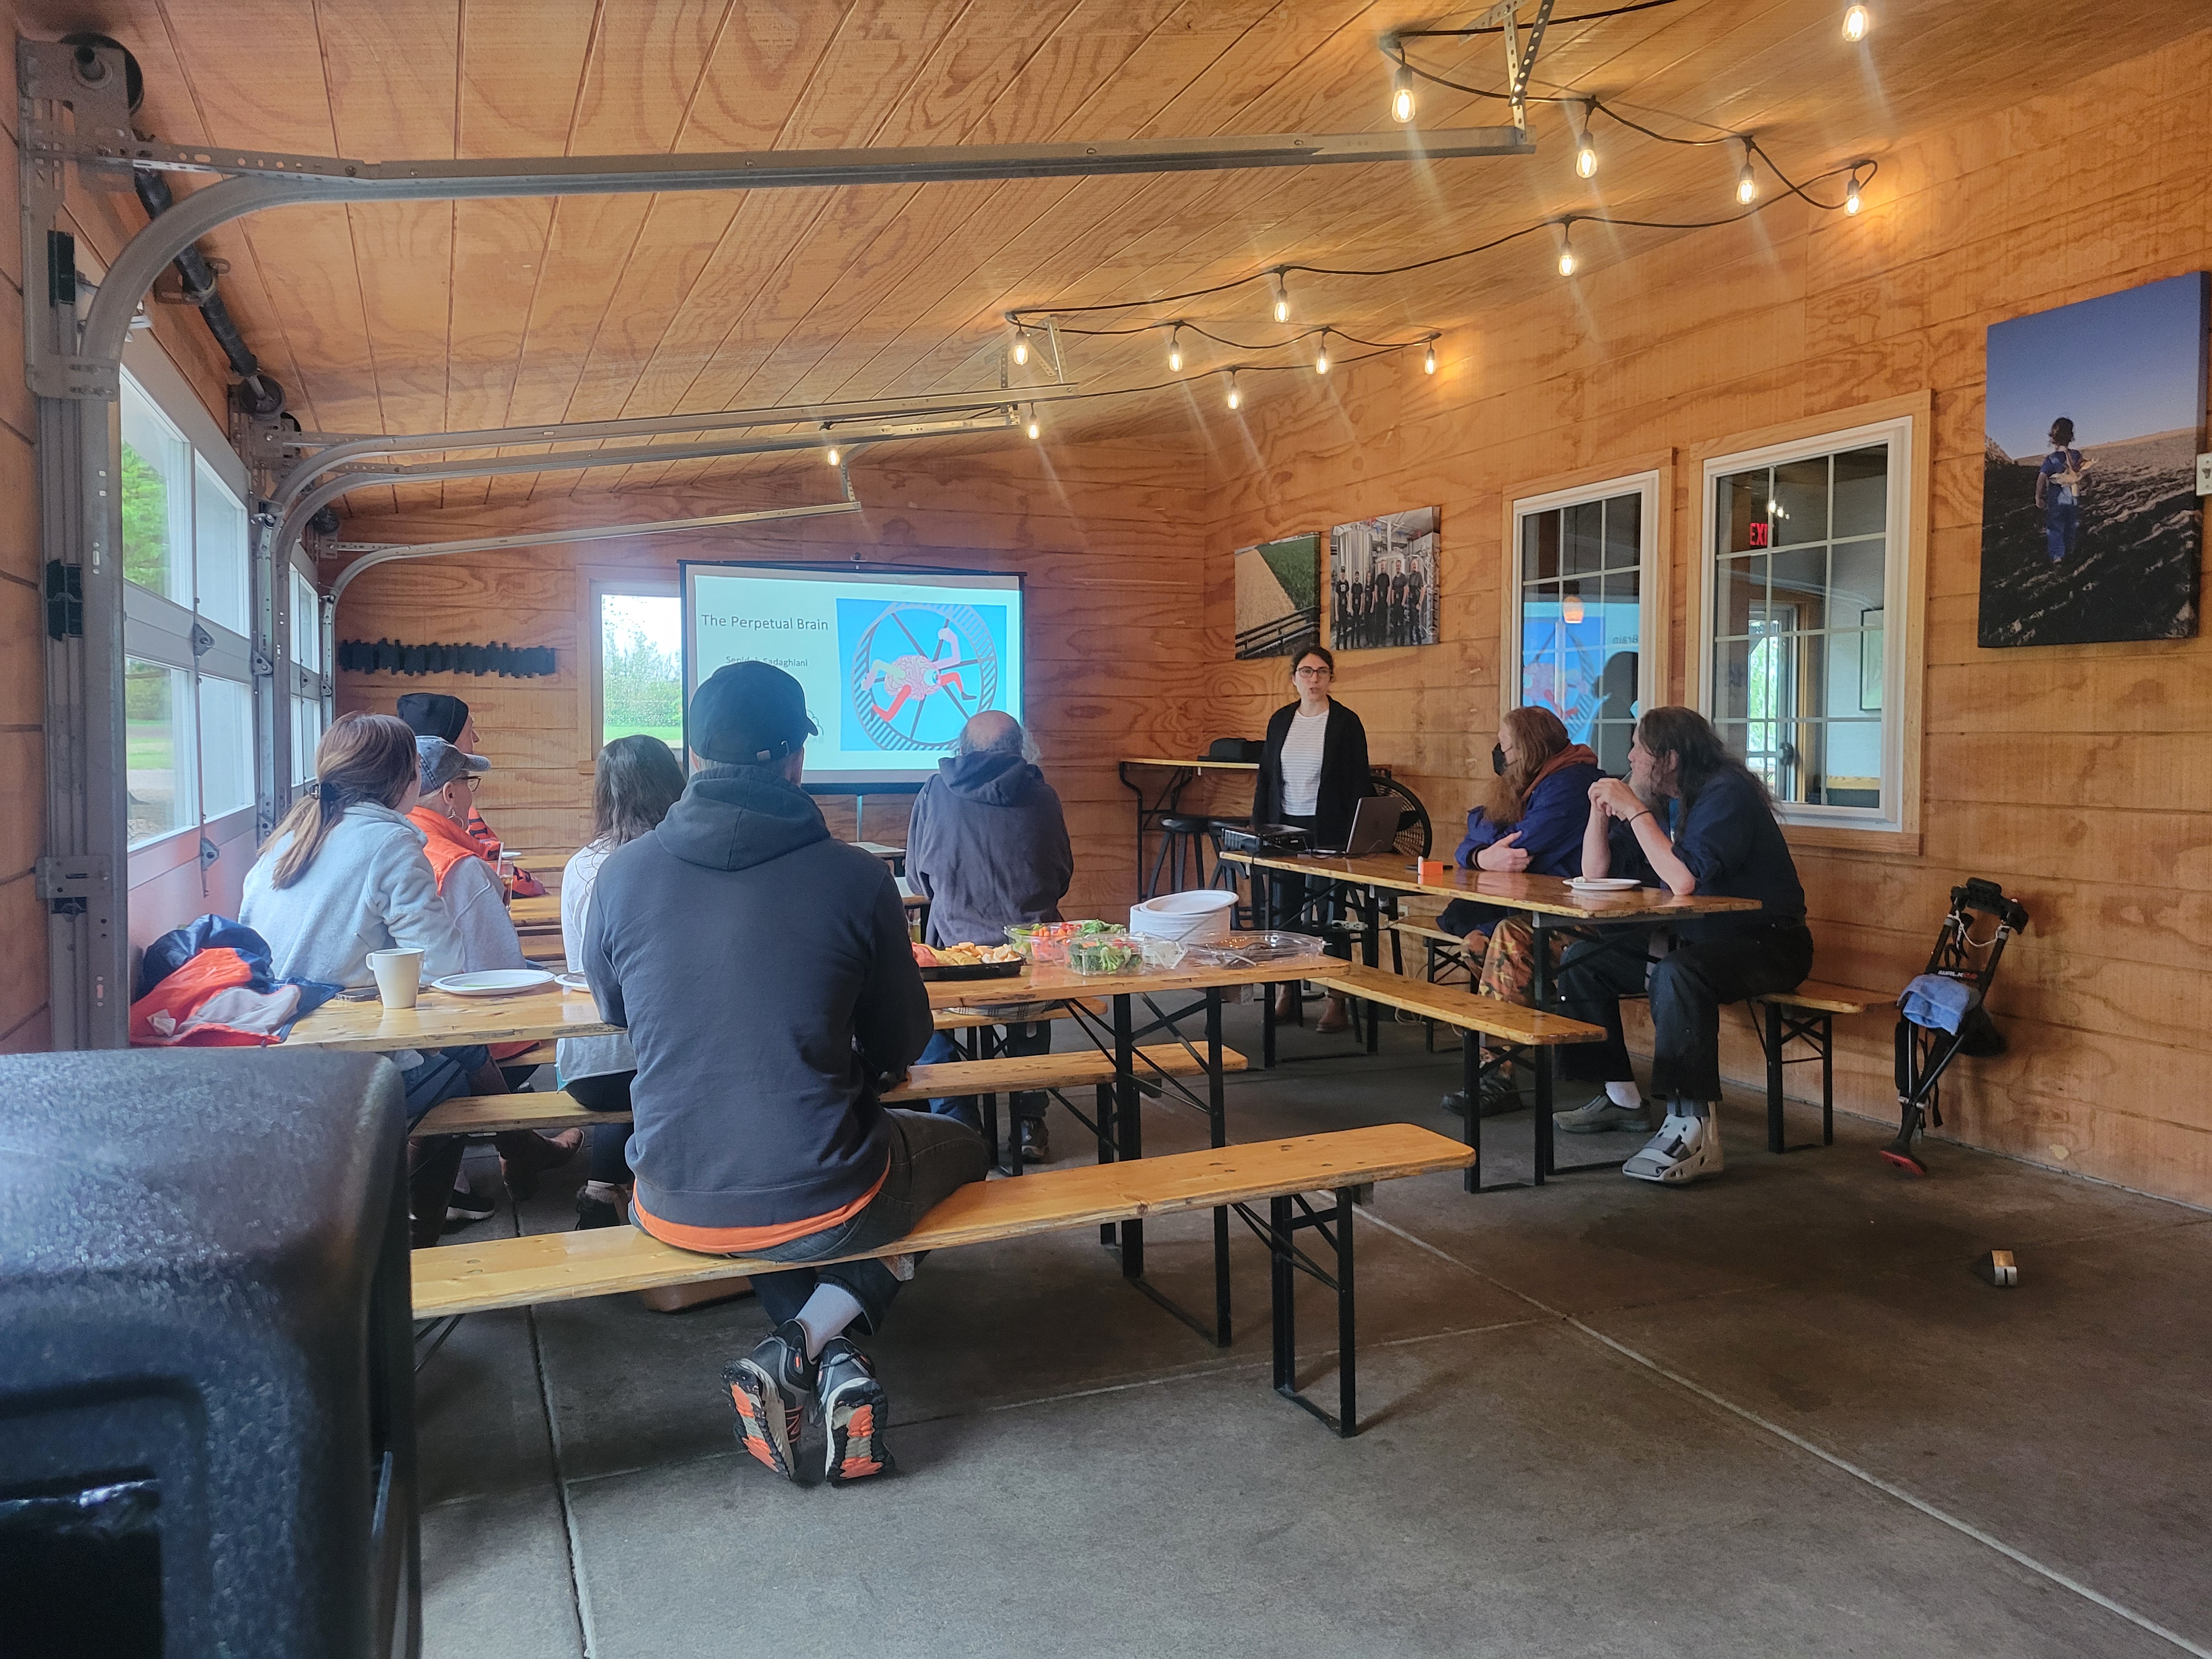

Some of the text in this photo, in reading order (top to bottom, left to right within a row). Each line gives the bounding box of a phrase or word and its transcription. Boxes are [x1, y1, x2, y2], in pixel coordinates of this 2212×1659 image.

[1750, 523, 1768, 545] EXI
[701, 614, 828, 631] The Perpetual Brain
